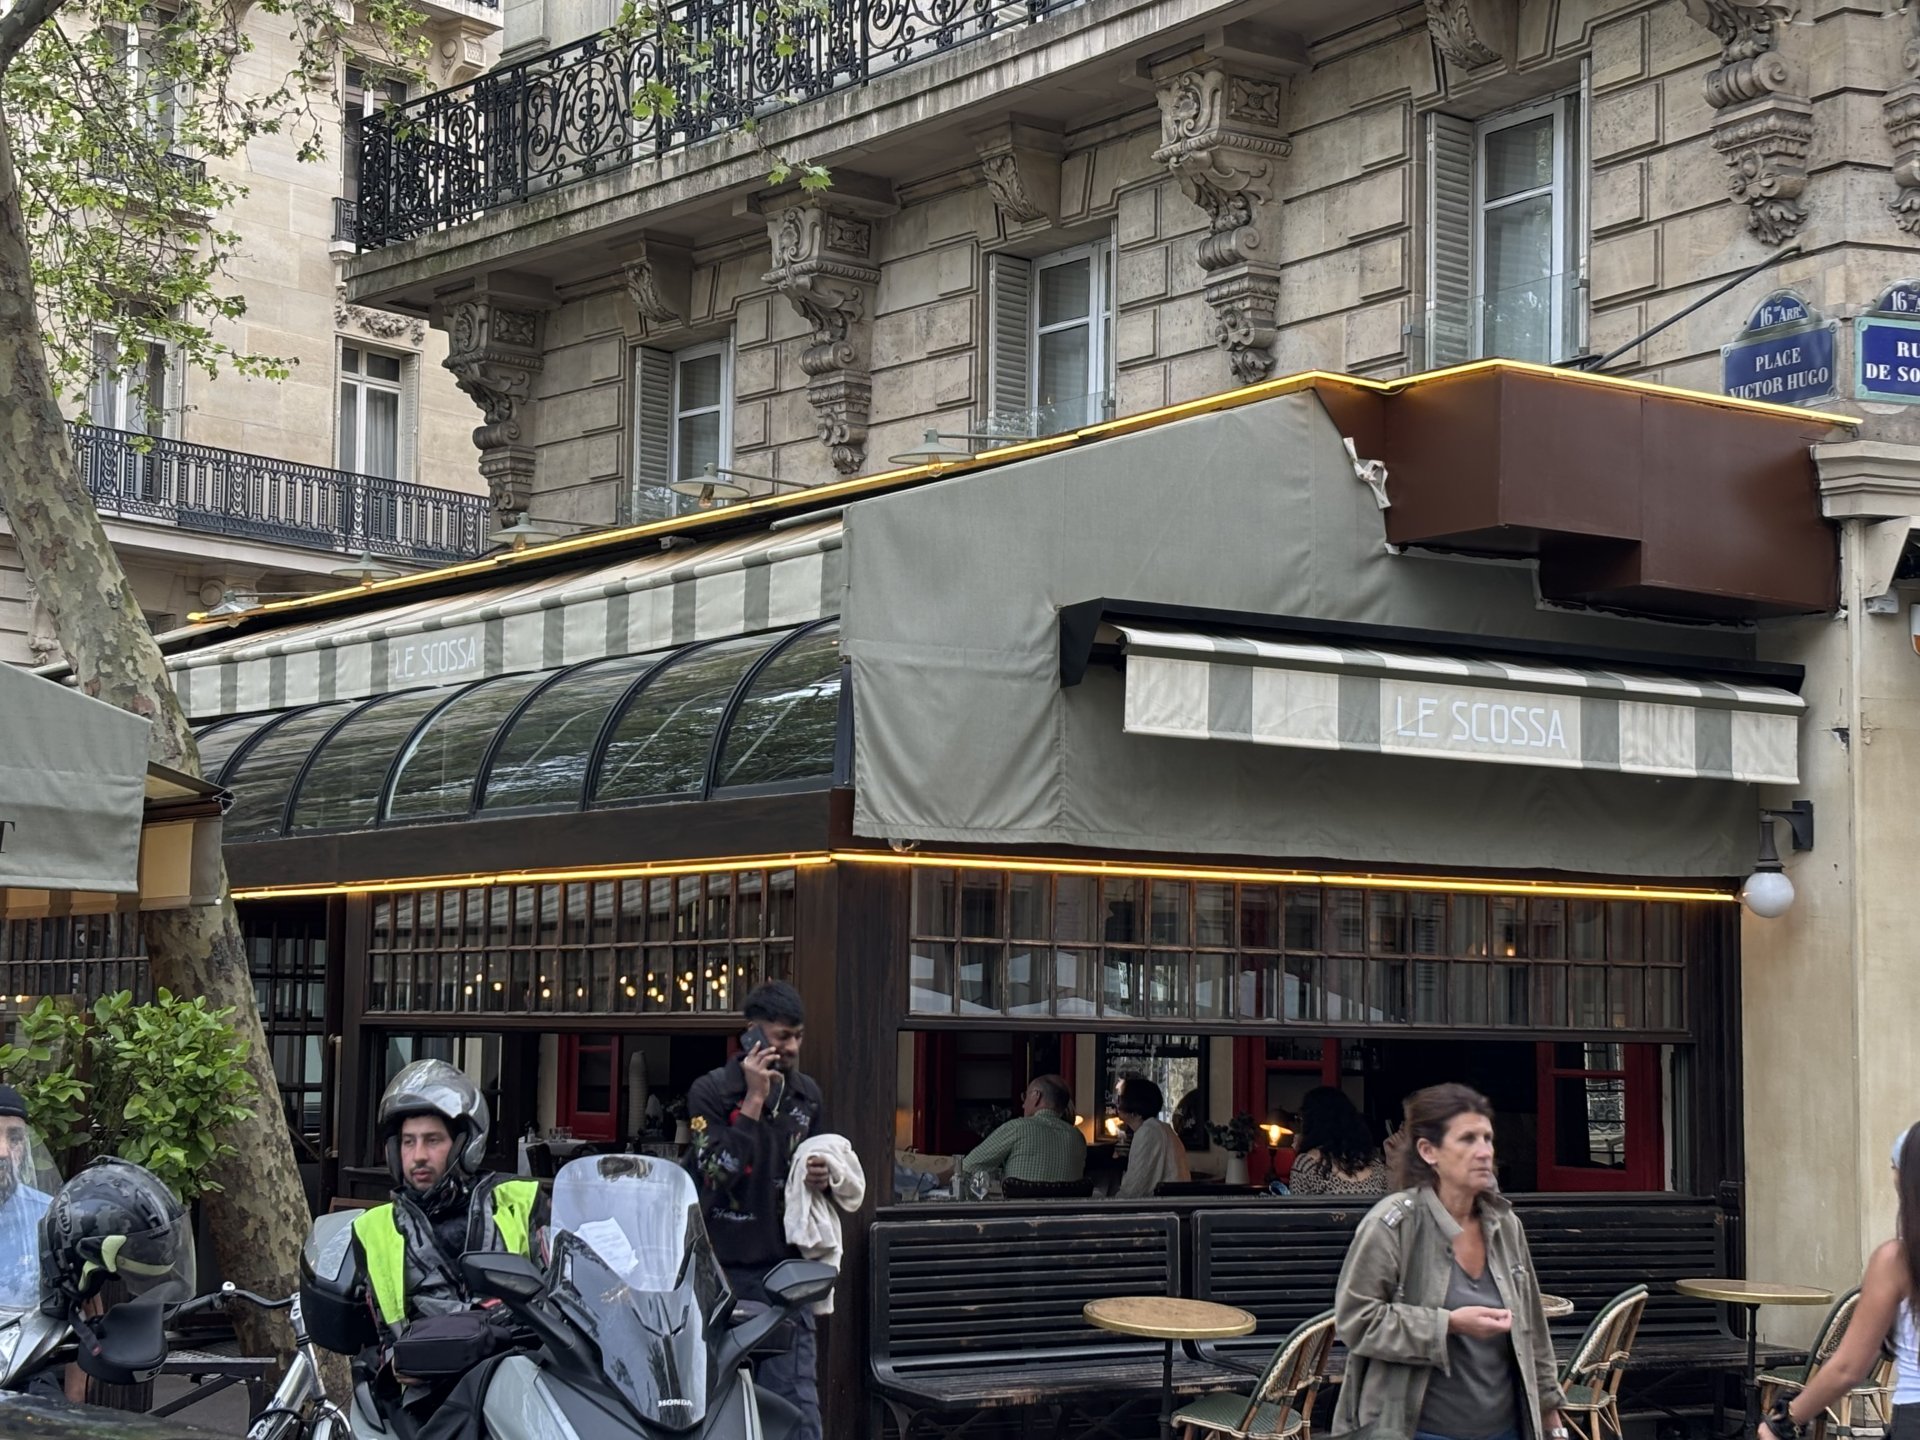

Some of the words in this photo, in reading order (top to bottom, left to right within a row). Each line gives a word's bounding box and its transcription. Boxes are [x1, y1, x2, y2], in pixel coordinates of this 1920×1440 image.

[1755, 347, 1801, 372] PLACE
[1866, 363, 1891, 380] DE
[1729, 376, 1783, 400] VICTOR
[1787, 367, 1829, 390] HUGO
[395, 646, 415, 679] LE
[421, 636, 476, 676] SCOSSA
[1396, 695, 1439, 738] LE
[1451, 701, 1567, 749] SCOSSA
[657, 1399, 693, 1407] HONDA
